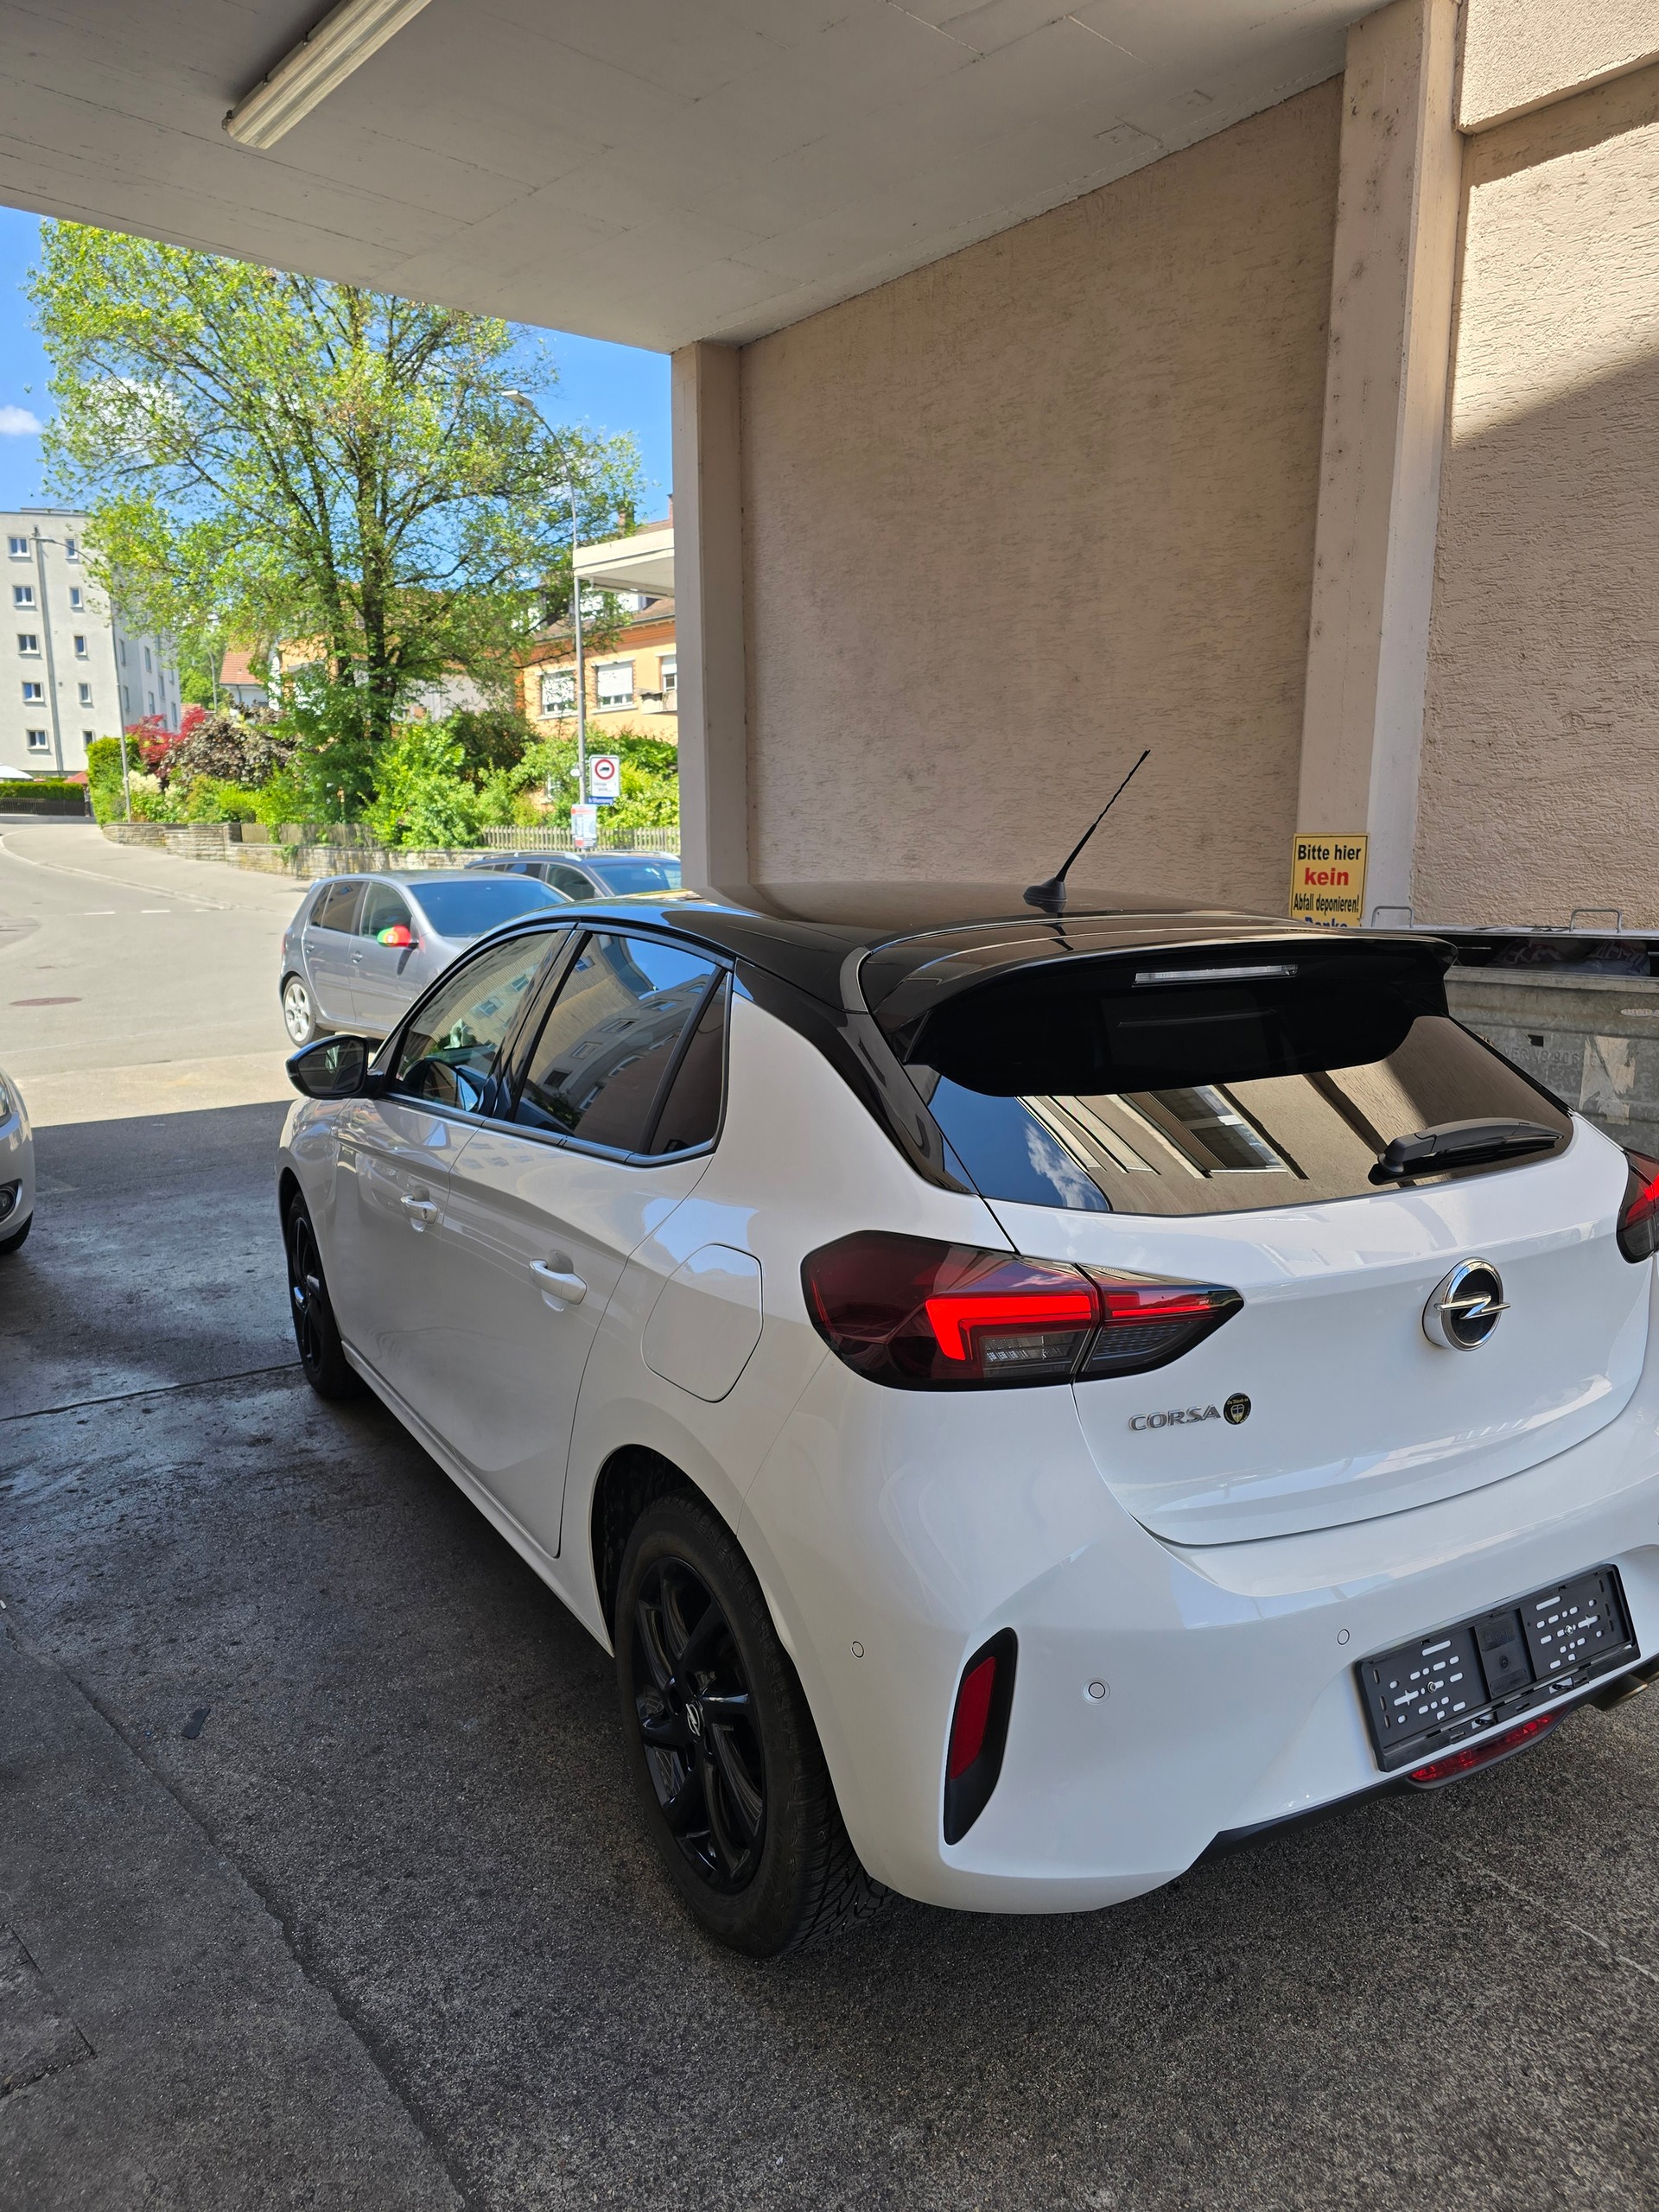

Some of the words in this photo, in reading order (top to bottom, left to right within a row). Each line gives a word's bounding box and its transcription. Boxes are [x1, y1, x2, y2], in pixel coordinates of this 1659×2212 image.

[1298, 844, 1330, 861] Bitte
[1334, 844, 1361, 861] hier
[1304, 867, 1349, 886] kein
[1294, 893, 1313, 911] Abfall
[1315, 893, 1359, 916] deponieren!
[1128, 1404, 1221, 1432] CORSA
